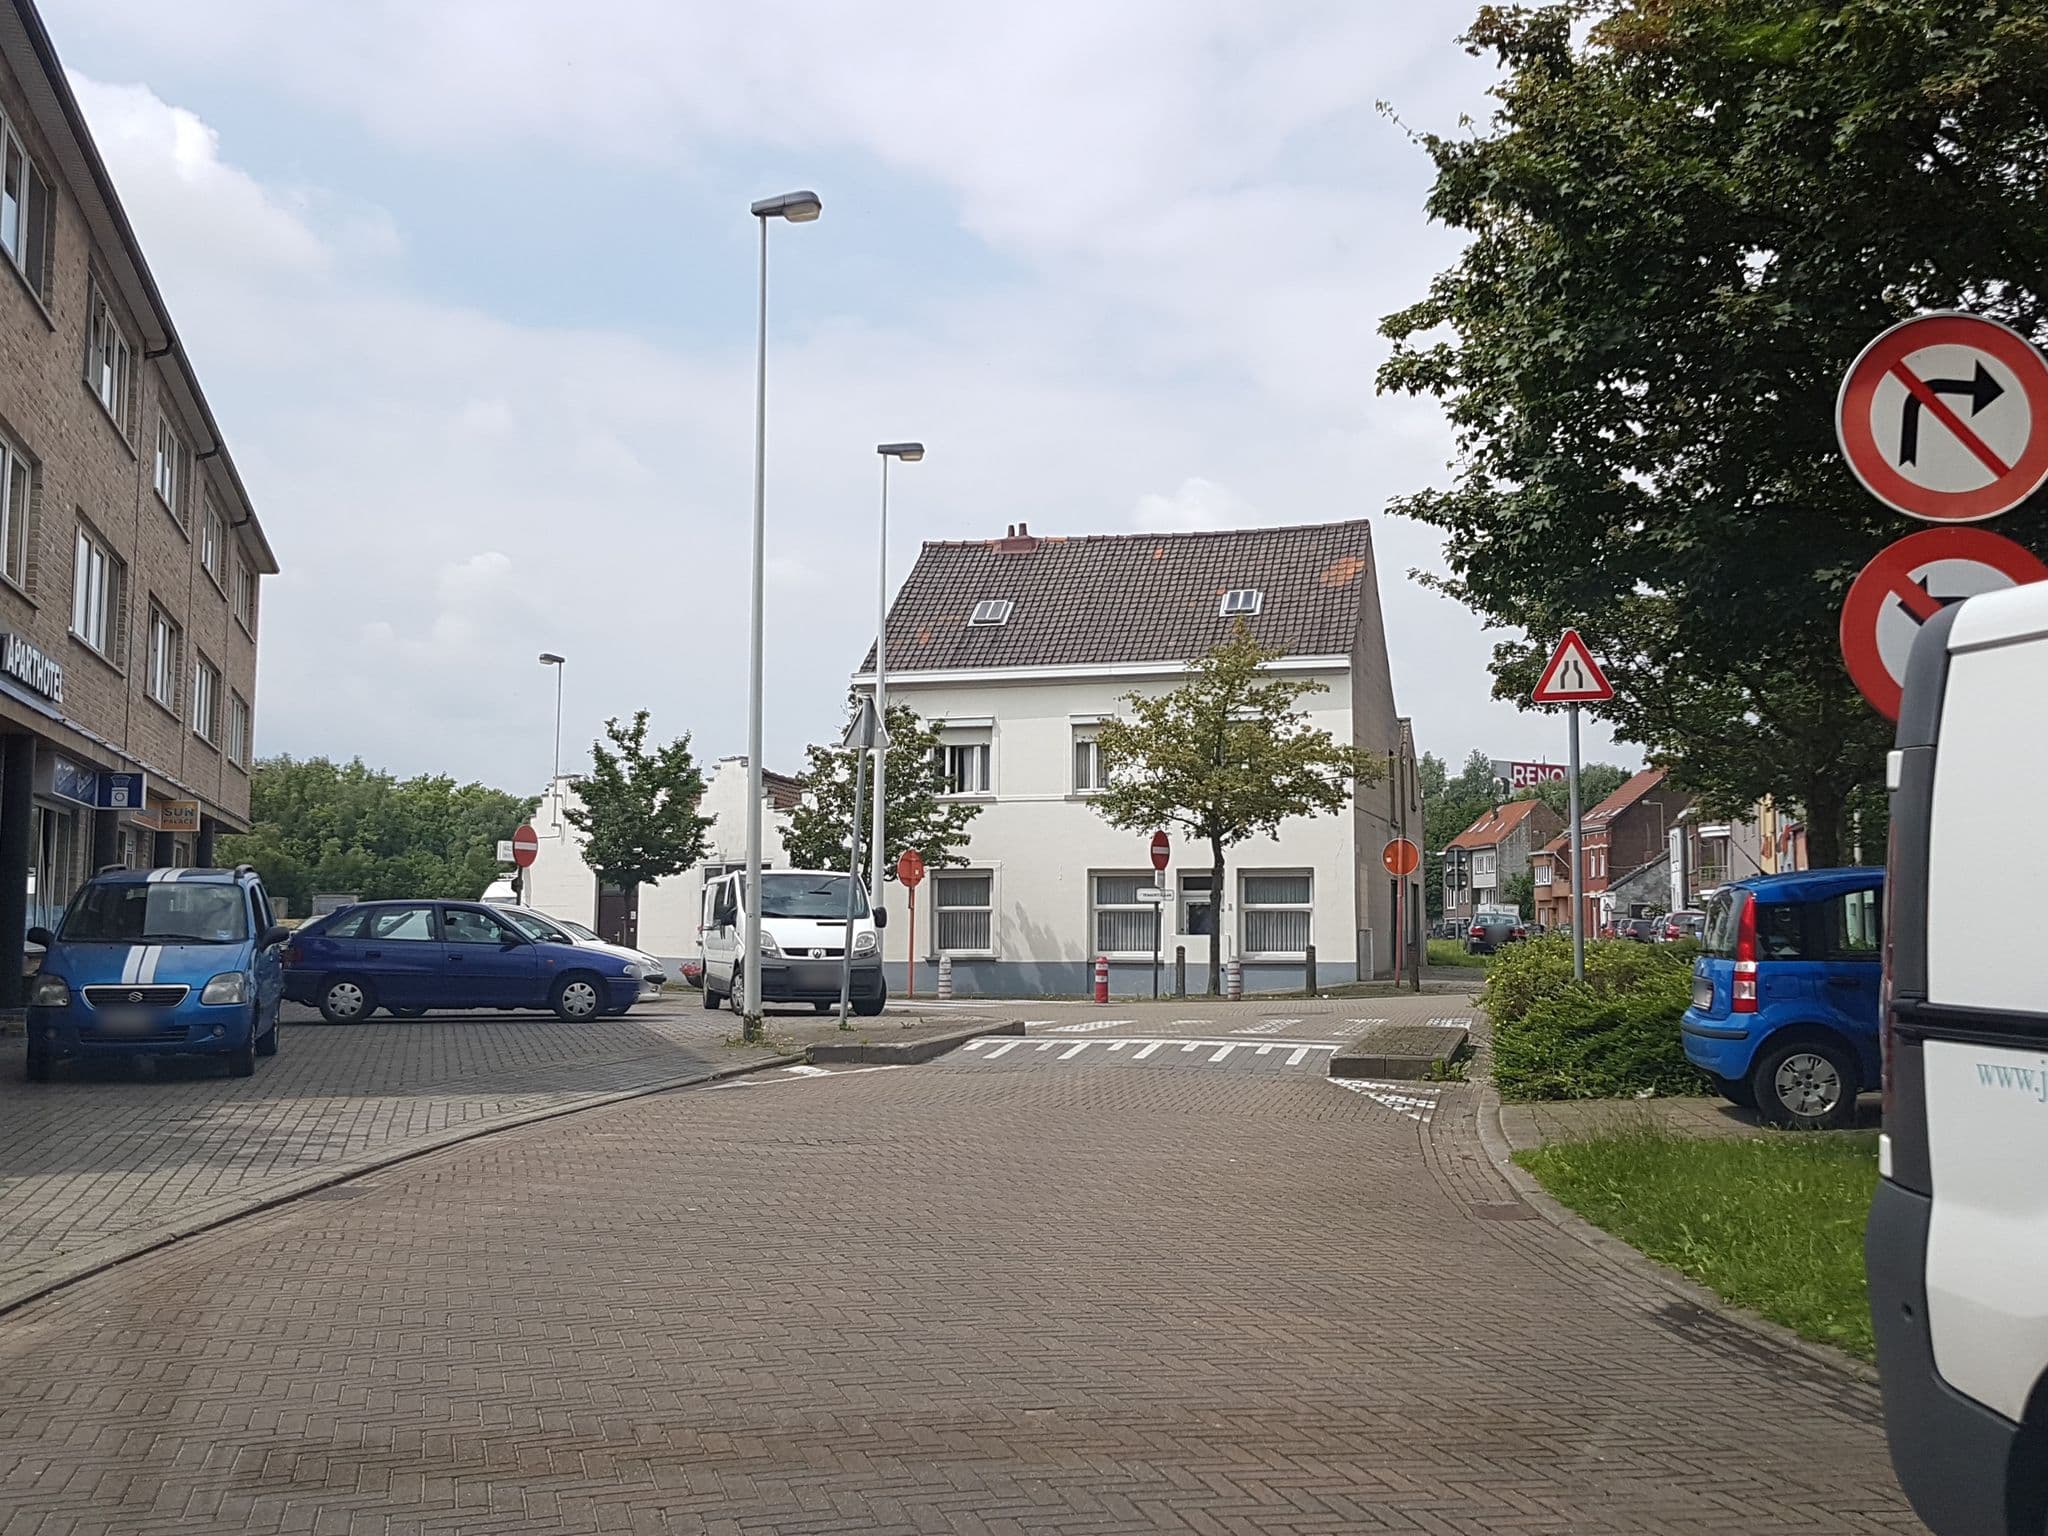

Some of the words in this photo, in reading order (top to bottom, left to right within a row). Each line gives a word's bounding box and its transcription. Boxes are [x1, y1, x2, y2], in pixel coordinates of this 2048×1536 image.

[7, 632, 63, 703] APARTHOTEL
[1513, 765, 1564, 785] RENO
[163, 808, 194, 817] SUN
